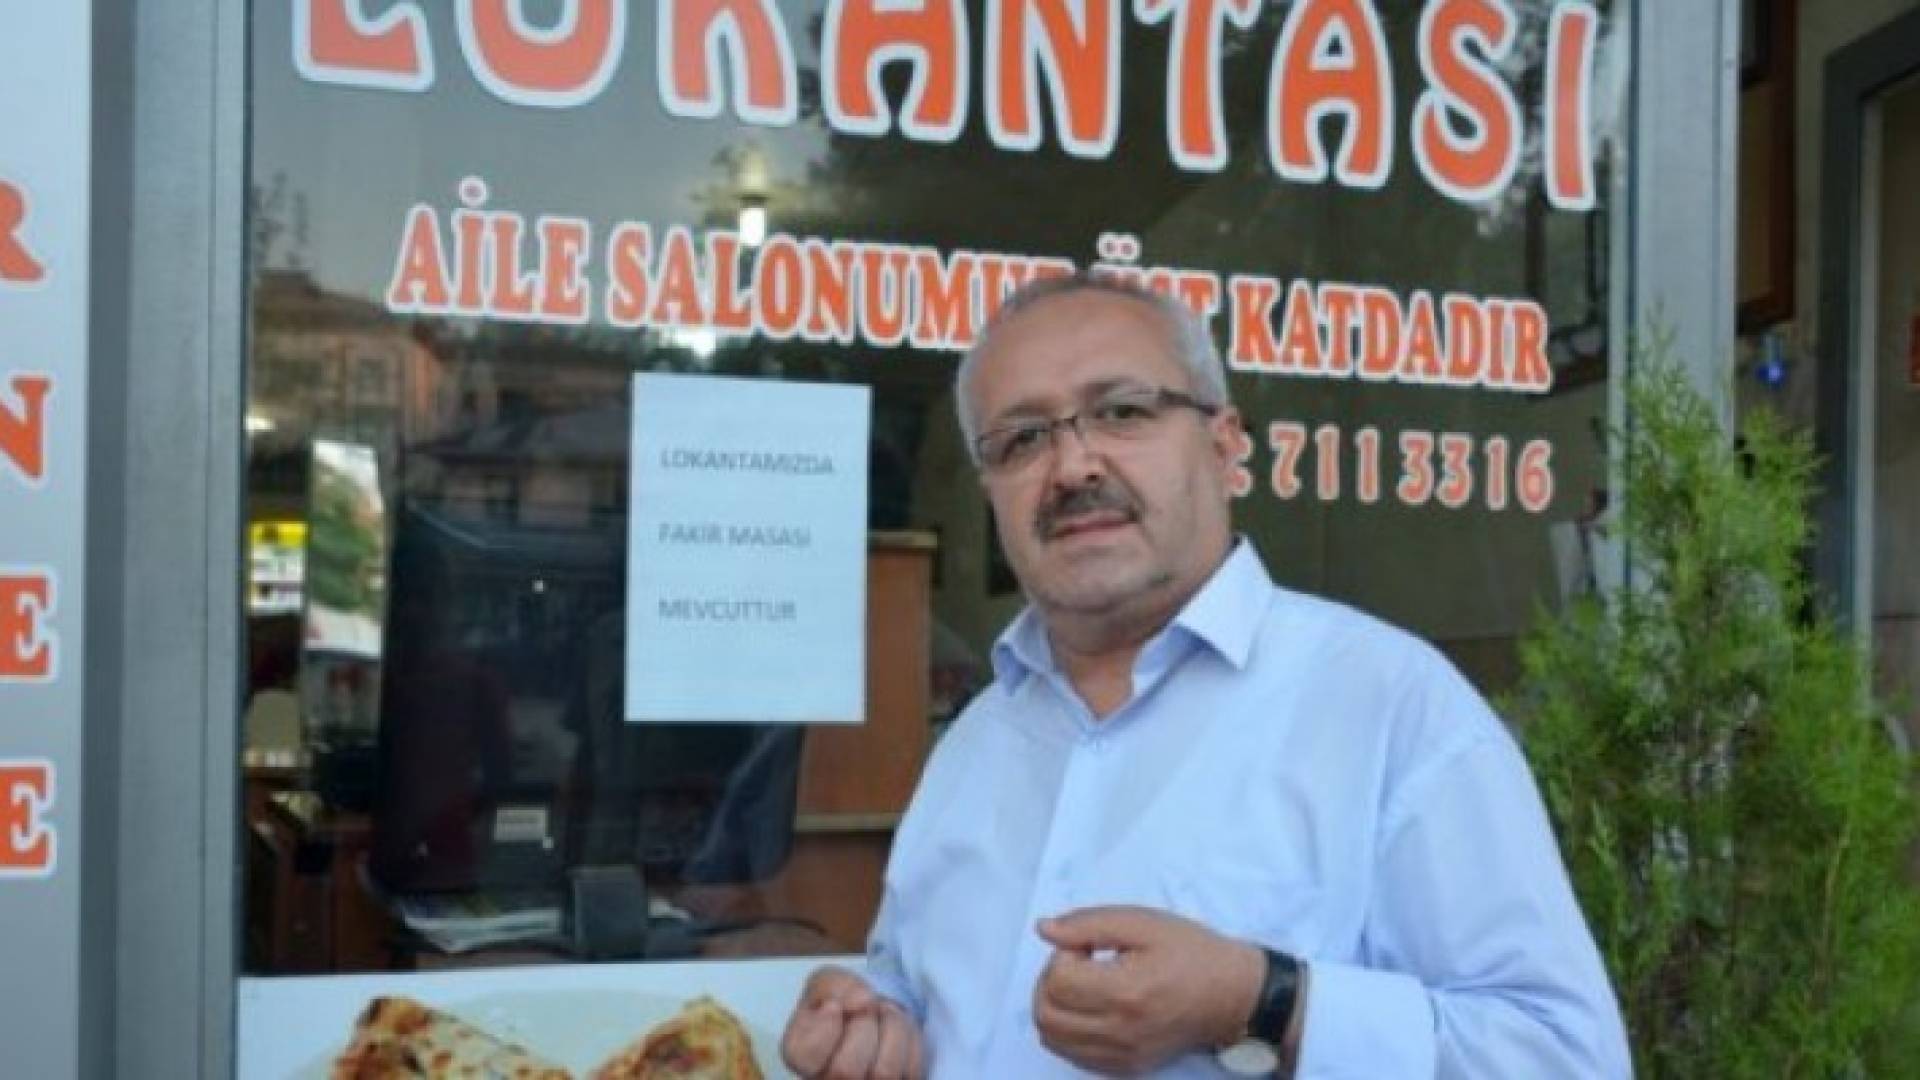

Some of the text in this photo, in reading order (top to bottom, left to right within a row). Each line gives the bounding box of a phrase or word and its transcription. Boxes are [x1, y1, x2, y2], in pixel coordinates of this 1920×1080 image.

[386, 176, 590, 324] AİLE
[606, 221, 1077, 350] SALONUM
[1228, 276, 1551, 391] KATDADIR
[660, 449, 836, 475] LOKANTAMIZDA
[729, 526, 812, 548] MASASI
[658, 598, 797, 621] MEVCUTTUR
